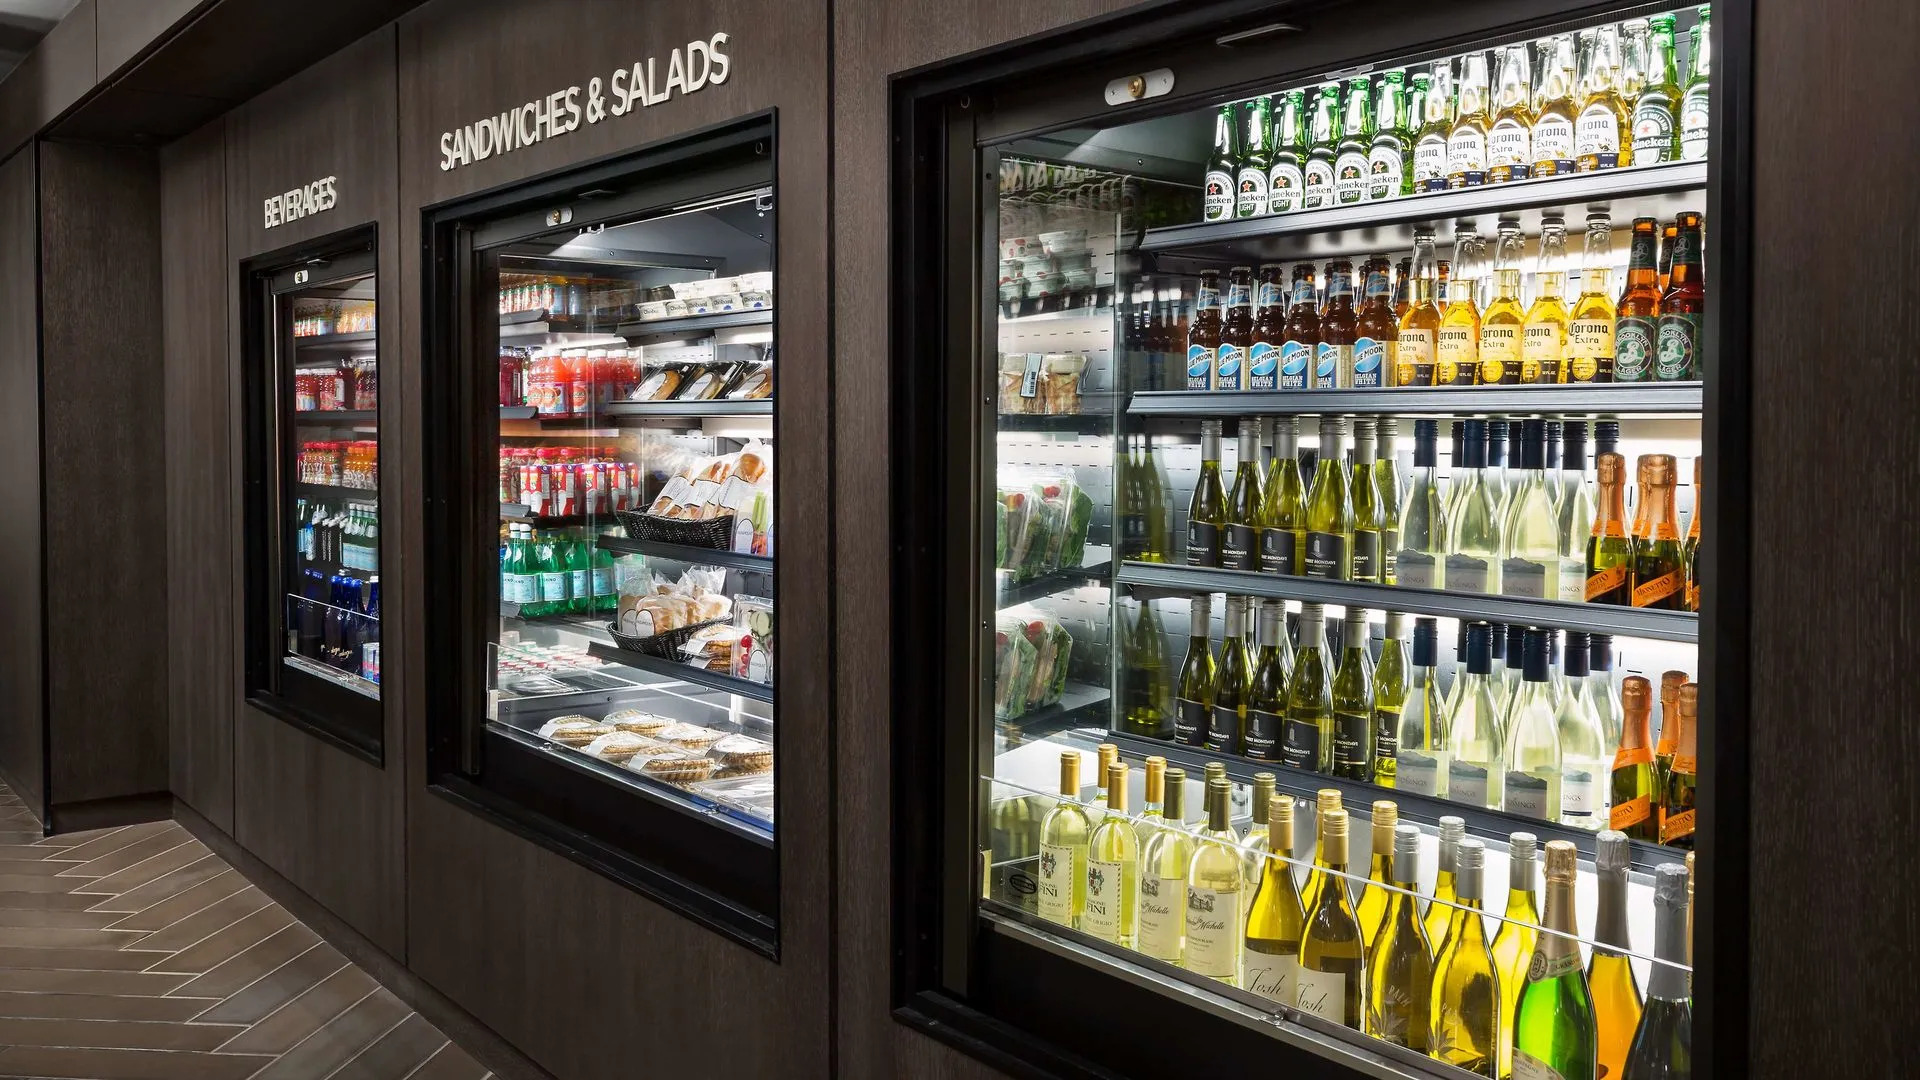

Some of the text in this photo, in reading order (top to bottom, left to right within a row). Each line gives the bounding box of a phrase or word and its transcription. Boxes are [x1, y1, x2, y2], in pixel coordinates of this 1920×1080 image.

[440, 32, 731, 172] SANDWICHES & SALADS
[264, 175, 338, 229] BEVERAGES
[1440, 330, 1467, 341] orona
[1568, 322, 1609, 337] Corona
[1483, 340, 1505, 349] Extra
[1574, 334, 1599, 344] Extra
[1225, 351, 1243, 363] MOON
[1260, 350, 1280, 362] MOON
[1291, 348, 1310, 361] MOON
[1321, 350, 1338, 362] MOON
[1363, 345, 1384, 357] MOON
[1195, 352, 1213, 364] MOON
[1617, 365, 1642, 375] LAGER
[1087, 902, 1106, 916] FINI
[1197, 919, 1226, 931] Michelle
[1249, 967, 1285, 995] Josh
[1297, 983, 1328, 1013] Josh
